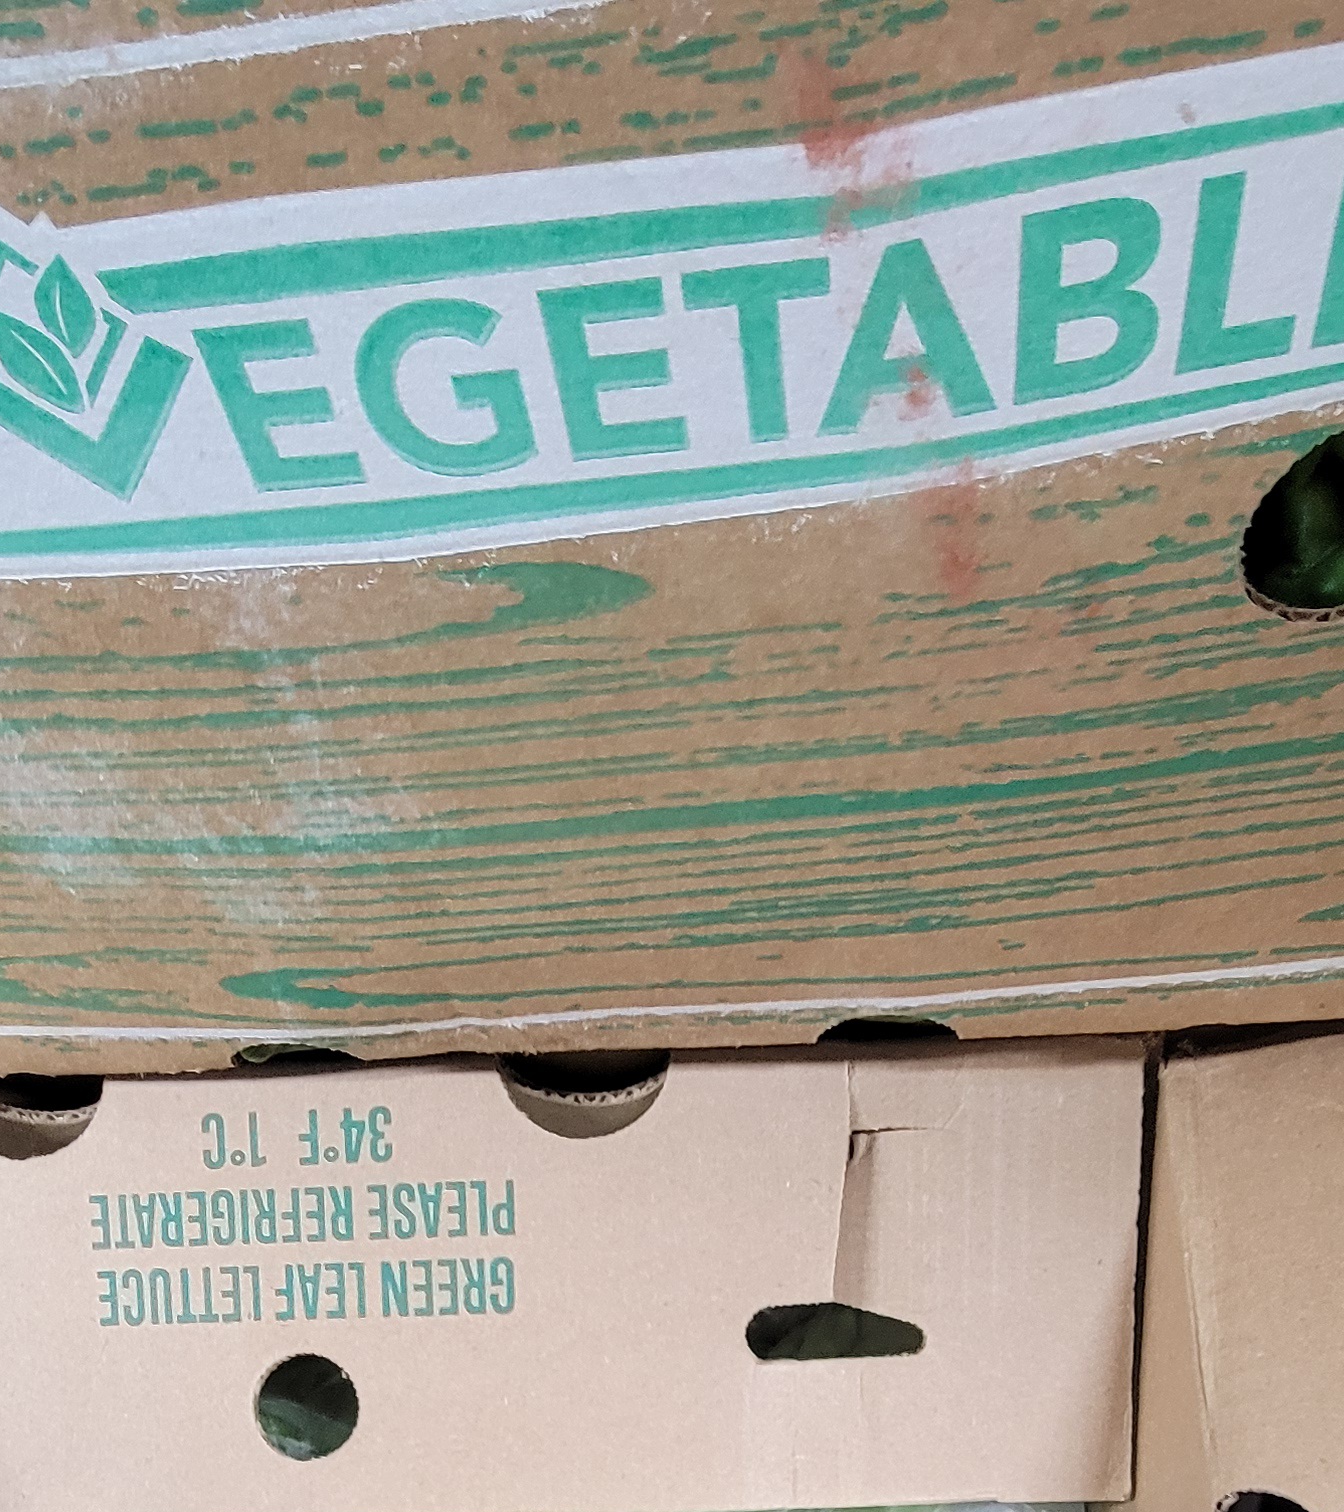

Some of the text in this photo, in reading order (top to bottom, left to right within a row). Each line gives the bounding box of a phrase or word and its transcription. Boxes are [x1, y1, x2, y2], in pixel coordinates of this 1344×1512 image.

[89, 1179, 516, 1250] PLEASE REFRIGERATE
[97, 1256, 515, 1327] GREEN LEAF LETTUCE
